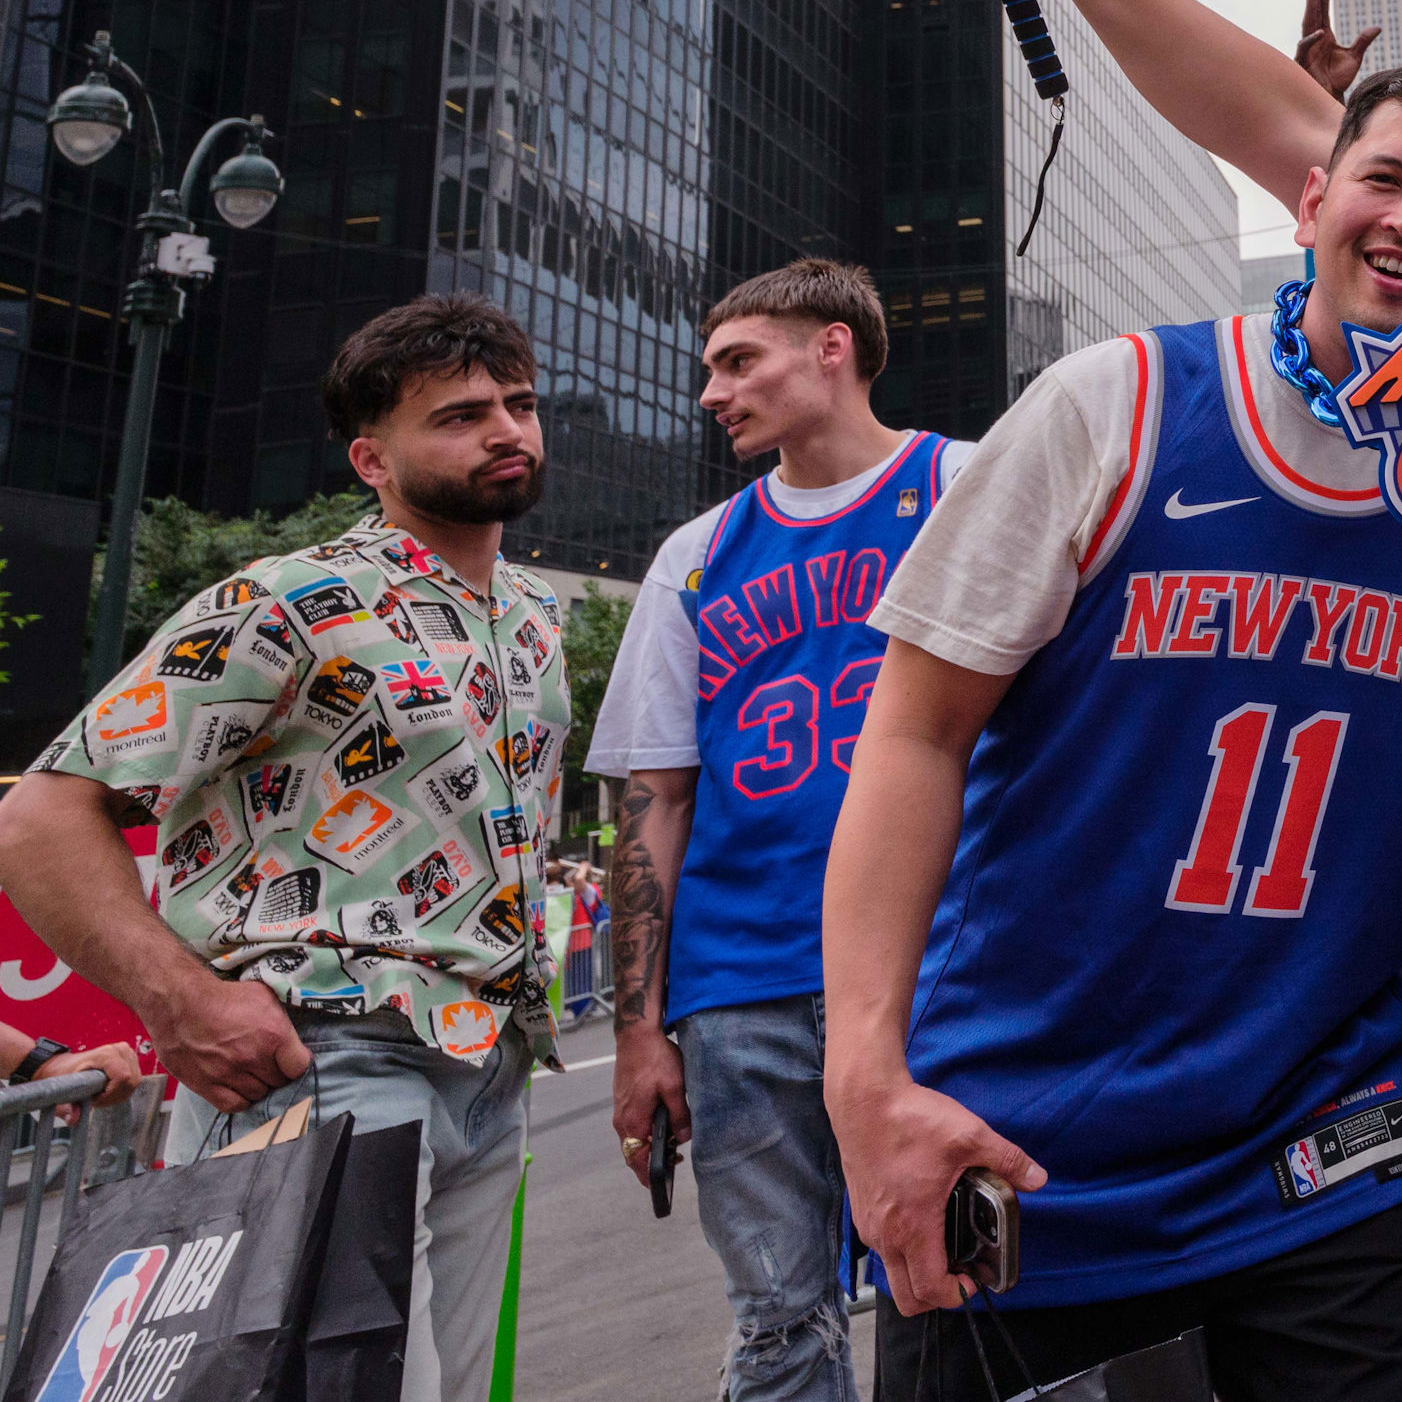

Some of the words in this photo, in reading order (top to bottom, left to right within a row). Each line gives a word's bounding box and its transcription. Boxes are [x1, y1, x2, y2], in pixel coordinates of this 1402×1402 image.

[807, 547, 909, 628] YO
[299, 597, 316, 608] THE
[304, 598, 338, 615] PLAYBOY
[308, 609, 329, 621] CLUB
[1110, 570, 1313, 660] NEW
[249, 639, 288, 671] London
[304, 706, 342, 729] TOKYO
[407, 708, 453, 725] London
[199, 715, 220, 762] PLAYBOY
[283, 768, 306, 812] London
[426, 779, 453, 815] PLAYBOY
[1164, 702, 1351, 918] 11
[471, 926, 506, 952] TOKYO
[1340, 1089, 1370, 1107] ALWAYS
[1370, 1087, 1377, 1096] A
[1338, 1110, 1382, 1131] ENGINEERED
[1323, 1141, 1336, 1154] 48
[143, 1230, 244, 1325] NBA
[102, 1328, 198, 1402] Store
